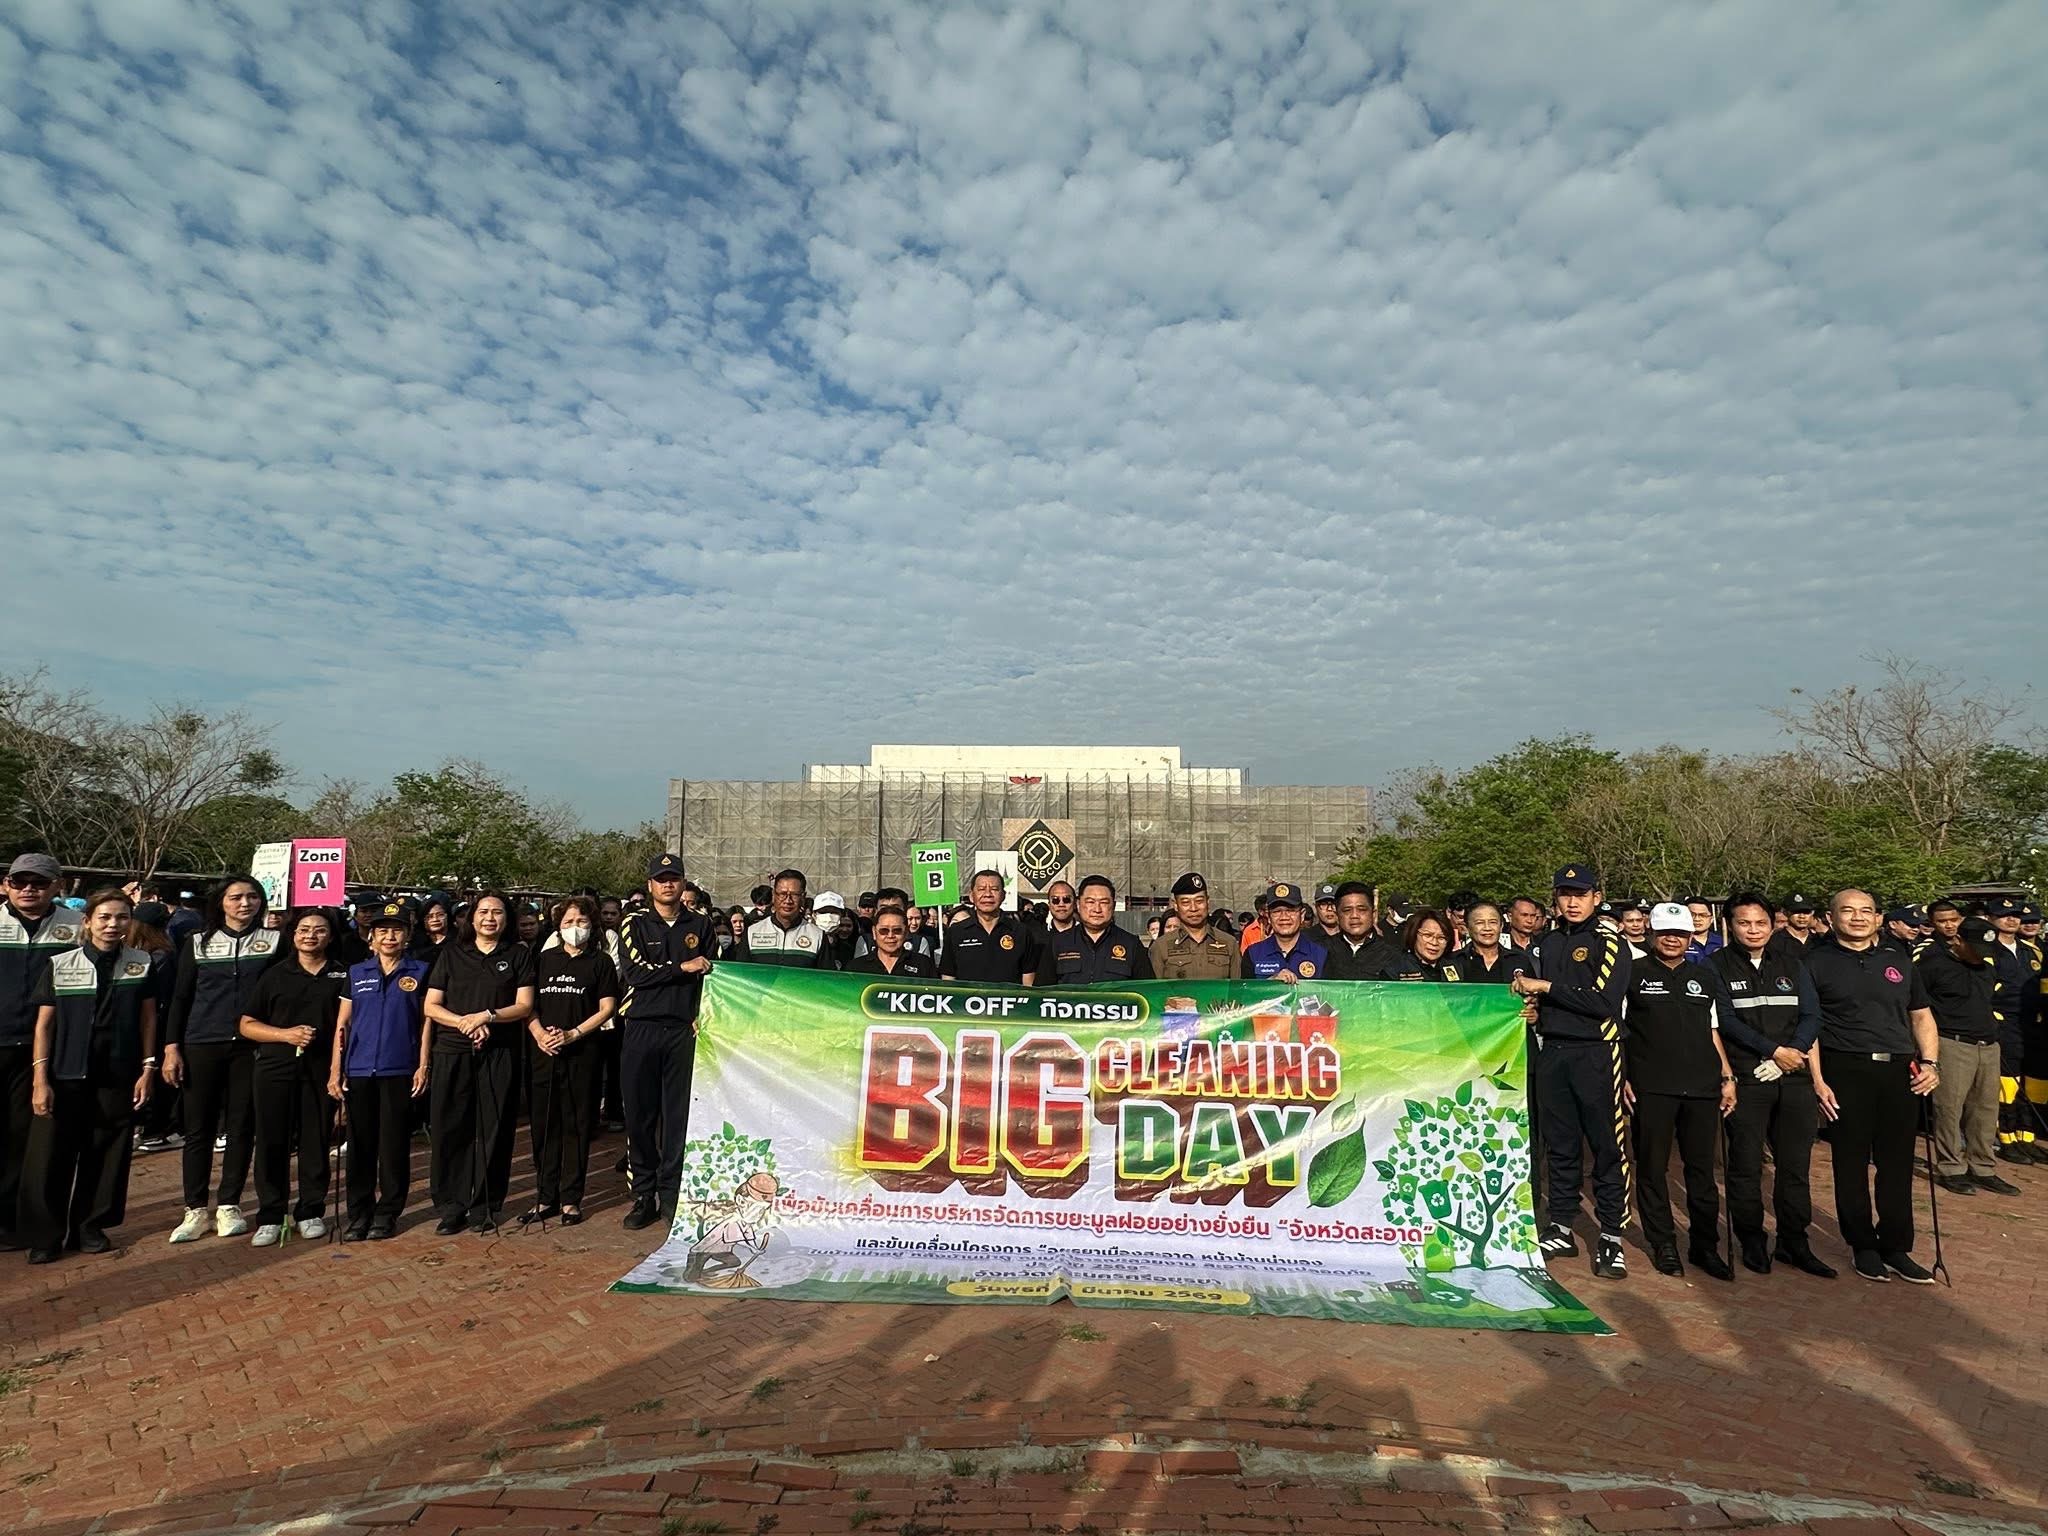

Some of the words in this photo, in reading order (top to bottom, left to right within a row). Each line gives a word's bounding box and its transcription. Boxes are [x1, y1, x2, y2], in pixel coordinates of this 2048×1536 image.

[300, 849, 340, 862] Zone
[918, 850, 951, 862] Zone
[929, 872, 943, 888] B
[1018, 861, 1061, 880] UNESCO
[309, 872, 327, 889] A
[877, 992, 955, 1015] “KICK
[965, 995, 1029, 1017] OFF”
[1040, 998, 1139, 1021] กิจกรรม
[1095, 1036, 1342, 1102] CLEANING
[861, 1027, 1091, 1178] BIG
[1117, 1098, 1318, 1188] DAY
[774, 1189, 1270, 1237] เพื่อขับเคลื่อนการบริหารจัดการขยะมูลฝอยอย่างยั่งยืน
[1278, 1217, 1434, 1245] “จังหวัดสะอาด”
[856, 1234, 1032, 1255] และขับเคลื่อนโครงการ
[1038, 1243, 1194, 1260] “อยธยาเมืองสะอาด
[974, 1268, 1222, 1287] จังหวัดพะนครศรีอยุธยา
[1082, 1285, 1154, 1297] มีนาคม
[1164, 1289, 1223, 1302] 2569
